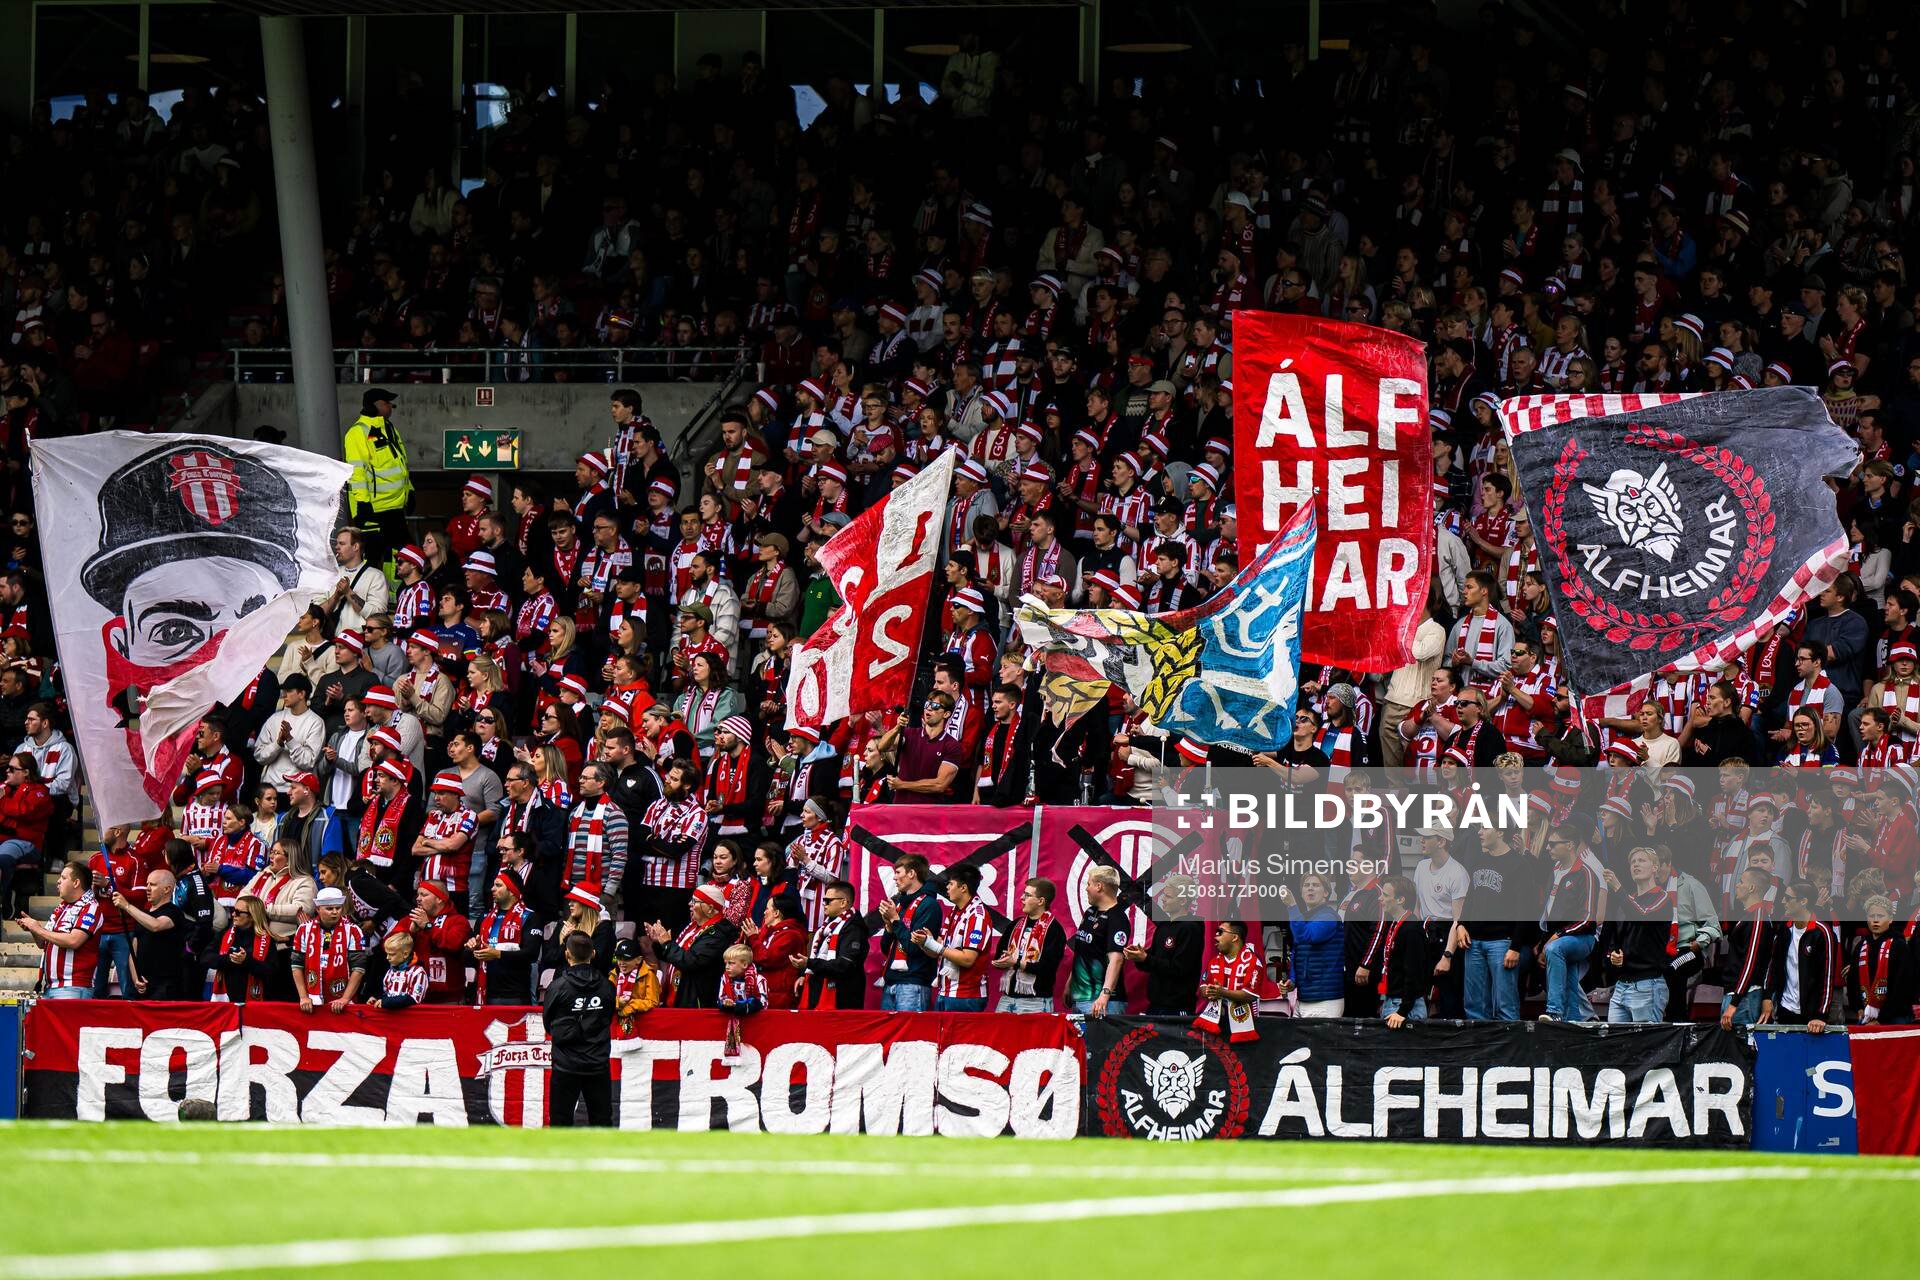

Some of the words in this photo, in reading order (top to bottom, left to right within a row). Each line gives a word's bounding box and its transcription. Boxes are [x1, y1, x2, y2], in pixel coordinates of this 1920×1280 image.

[1255, 358, 1421, 451] ÁLF
[1261, 457, 1400, 531] HEI
[1256, 537, 1420, 612] AR
[77, 1026, 469, 1127] FORZA
[493, 1049, 529, 1065] Forza
[609, 1039, 1081, 1139] TROMSØ
[1257, 1047, 1746, 1139] ÁLFHEIMAR
